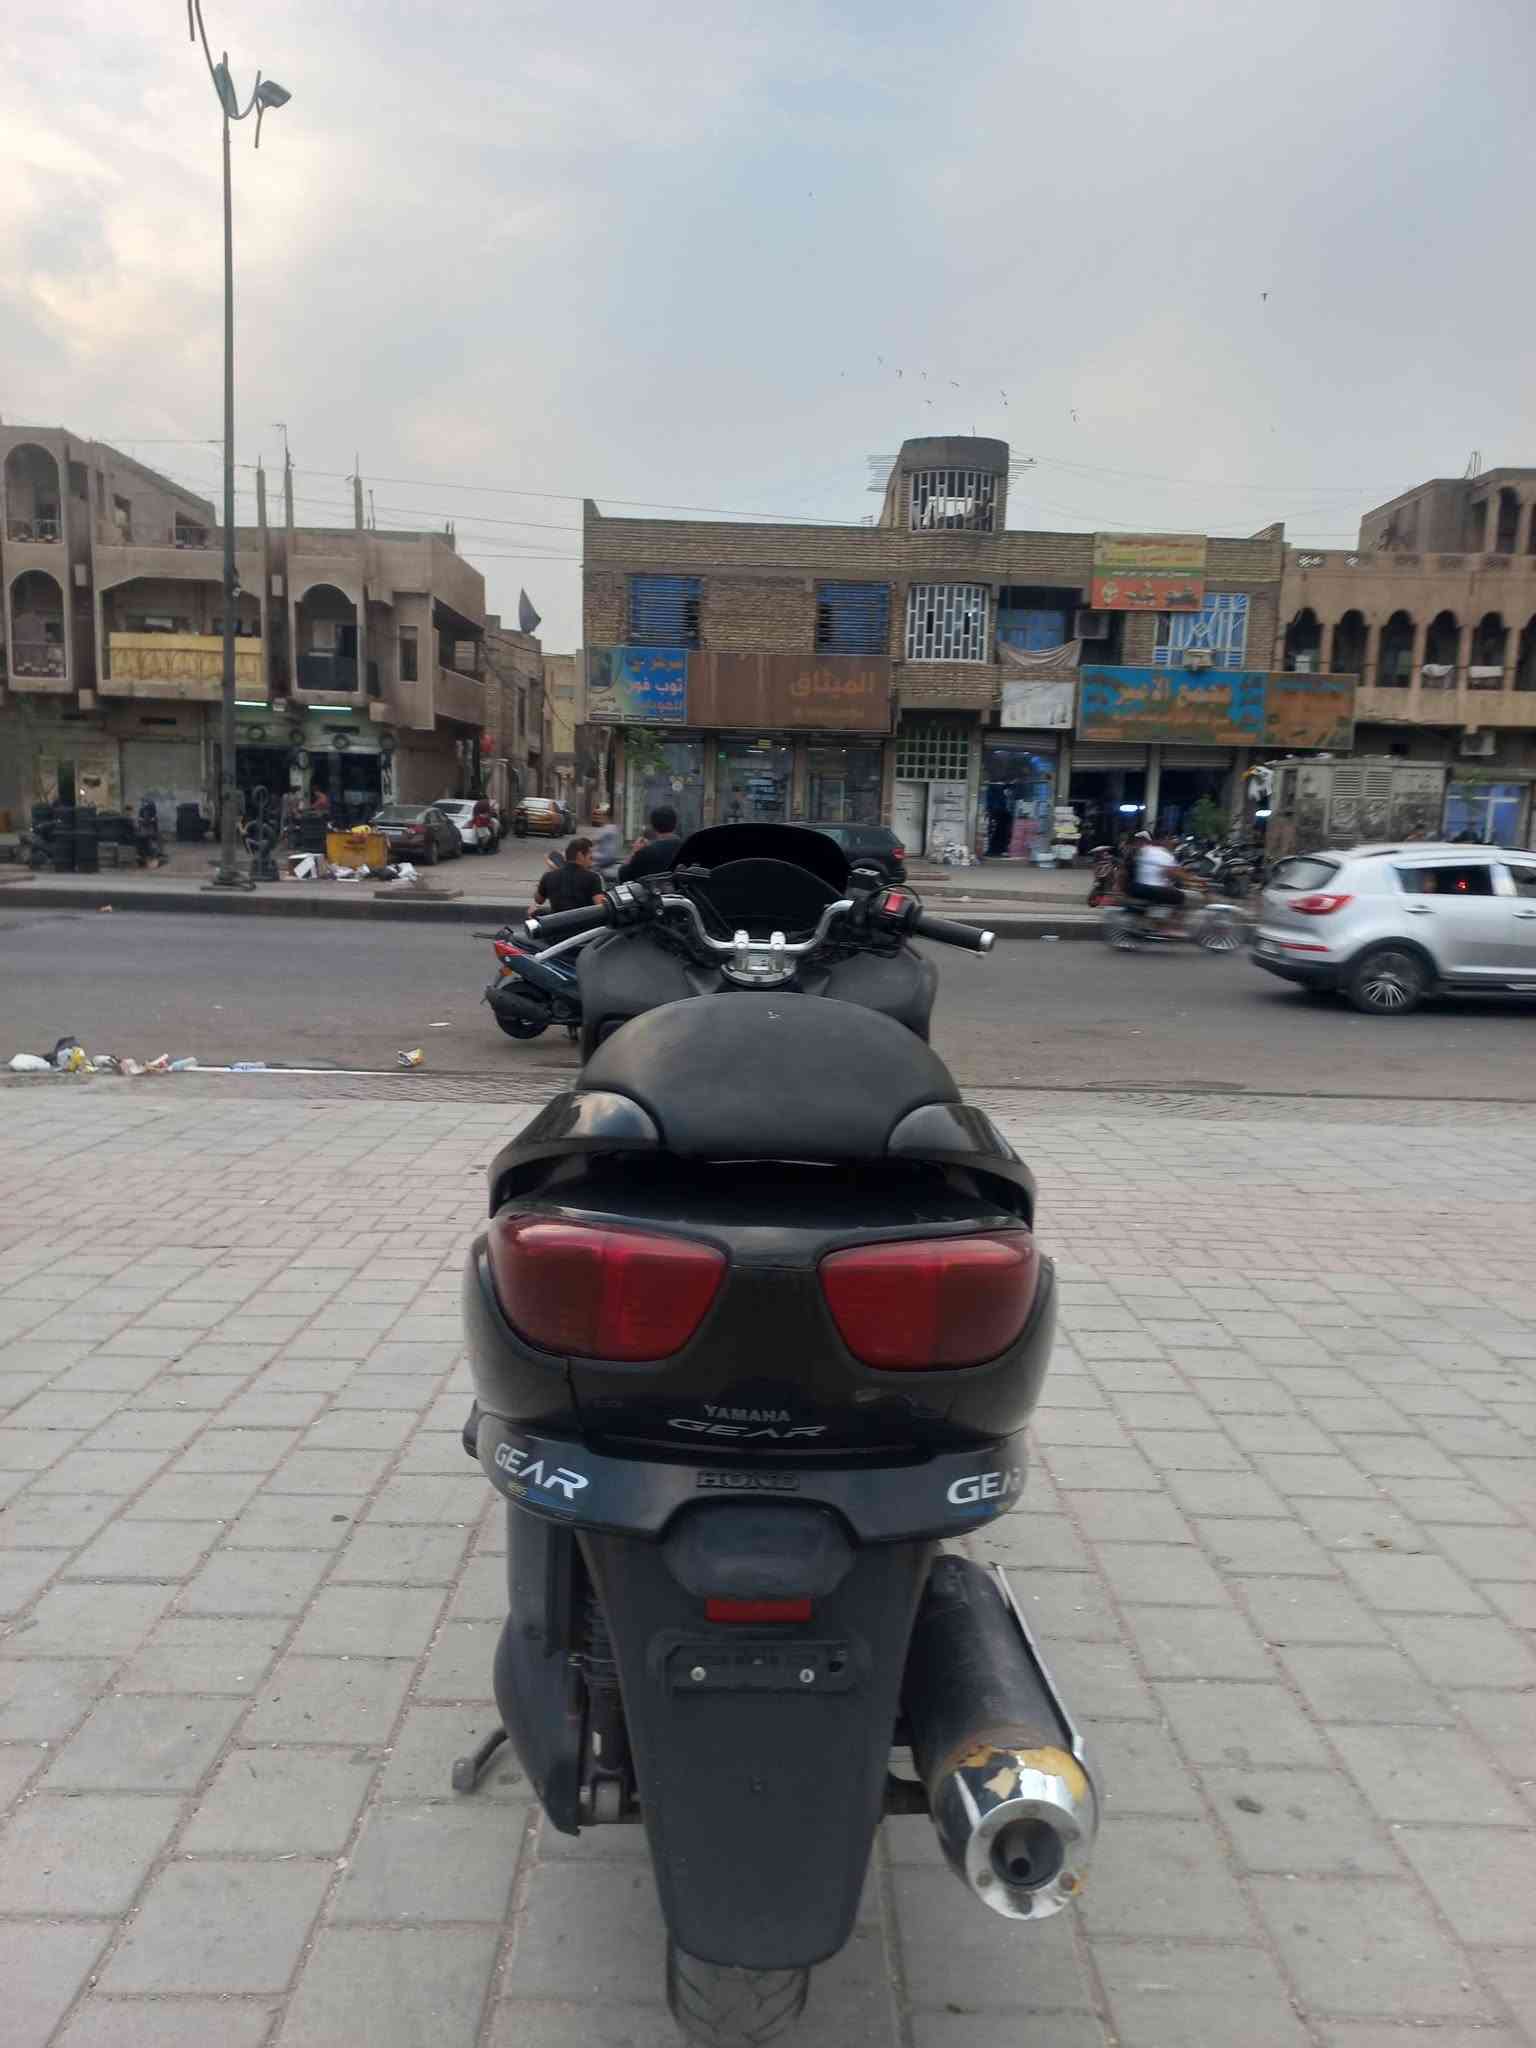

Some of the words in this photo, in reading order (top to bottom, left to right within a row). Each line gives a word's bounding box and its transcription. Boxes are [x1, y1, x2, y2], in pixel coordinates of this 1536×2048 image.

[703, 1403, 792, 1422] YAMAHA
[667, 1418, 828, 1438] GEAR
[494, 1442, 590, 1500] GEAR
